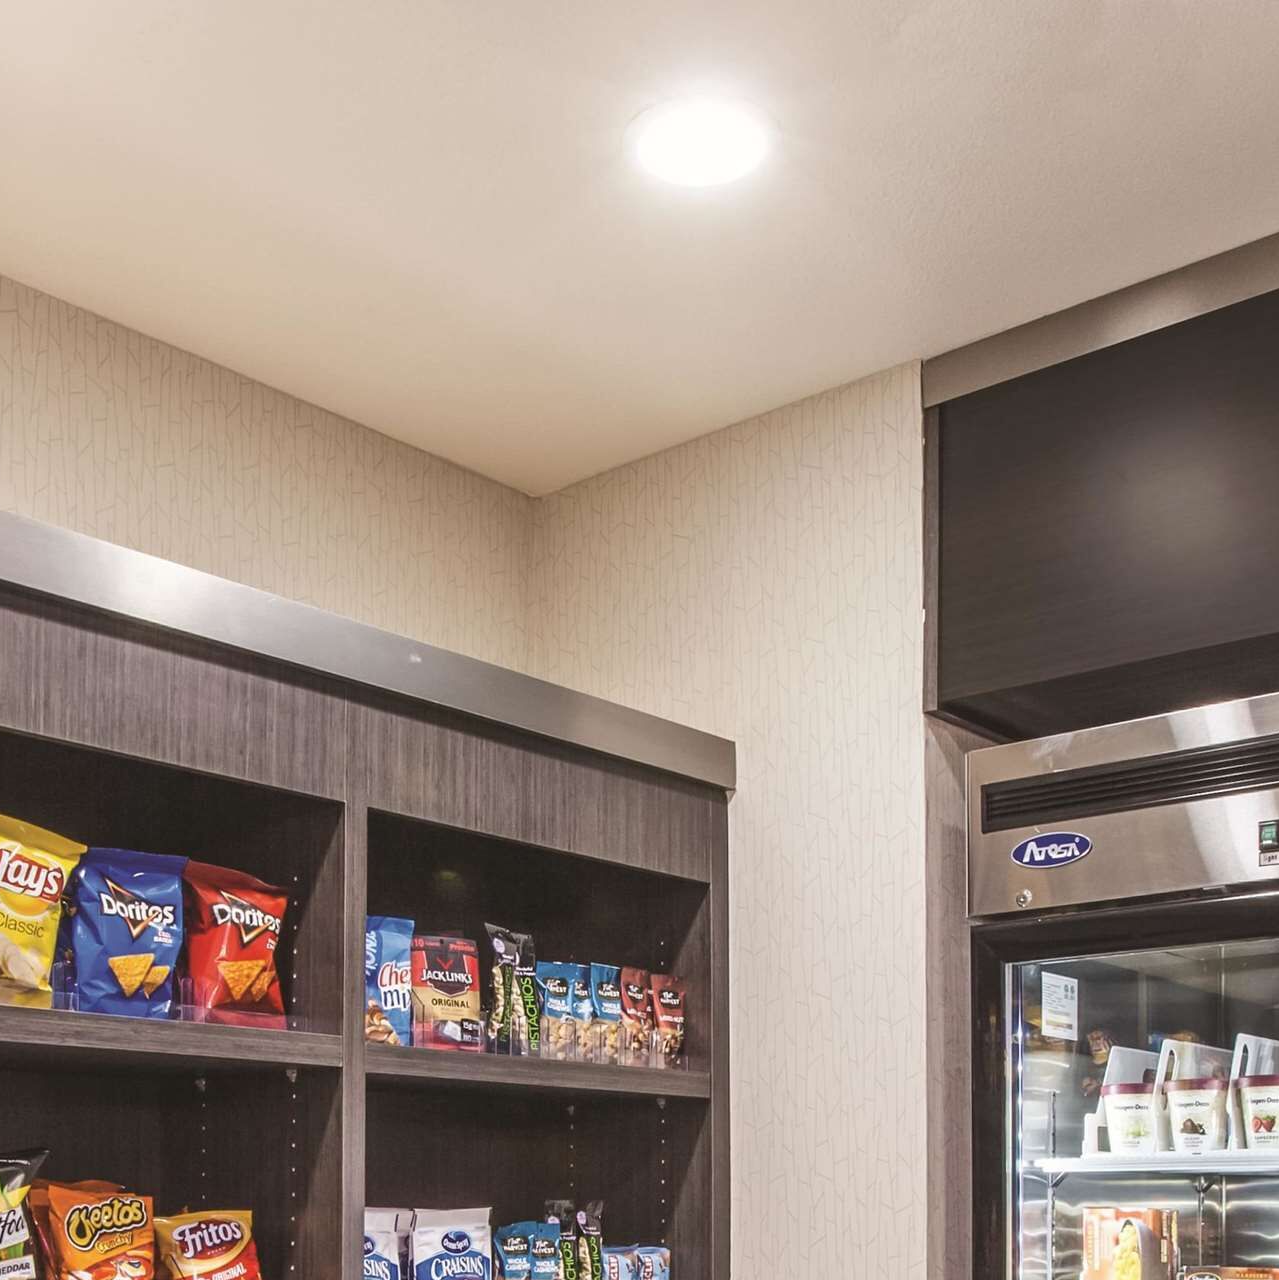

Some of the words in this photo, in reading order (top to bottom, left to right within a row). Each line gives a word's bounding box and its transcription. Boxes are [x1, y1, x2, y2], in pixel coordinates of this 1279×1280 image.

[100, 893, 175, 926] Doritos
[213, 904, 282, 936] Doritos
[431, 998, 471, 1008] ORIGINAL
[521, 976, 539, 1050] PISTACHIOS
[67, 1198, 145, 1248] Cheetos
[173, 1220, 242, 1258] Fritos
[95, 1232, 134, 1253] Crunchy
[431, 1256, 484, 1280] CRAISINS
